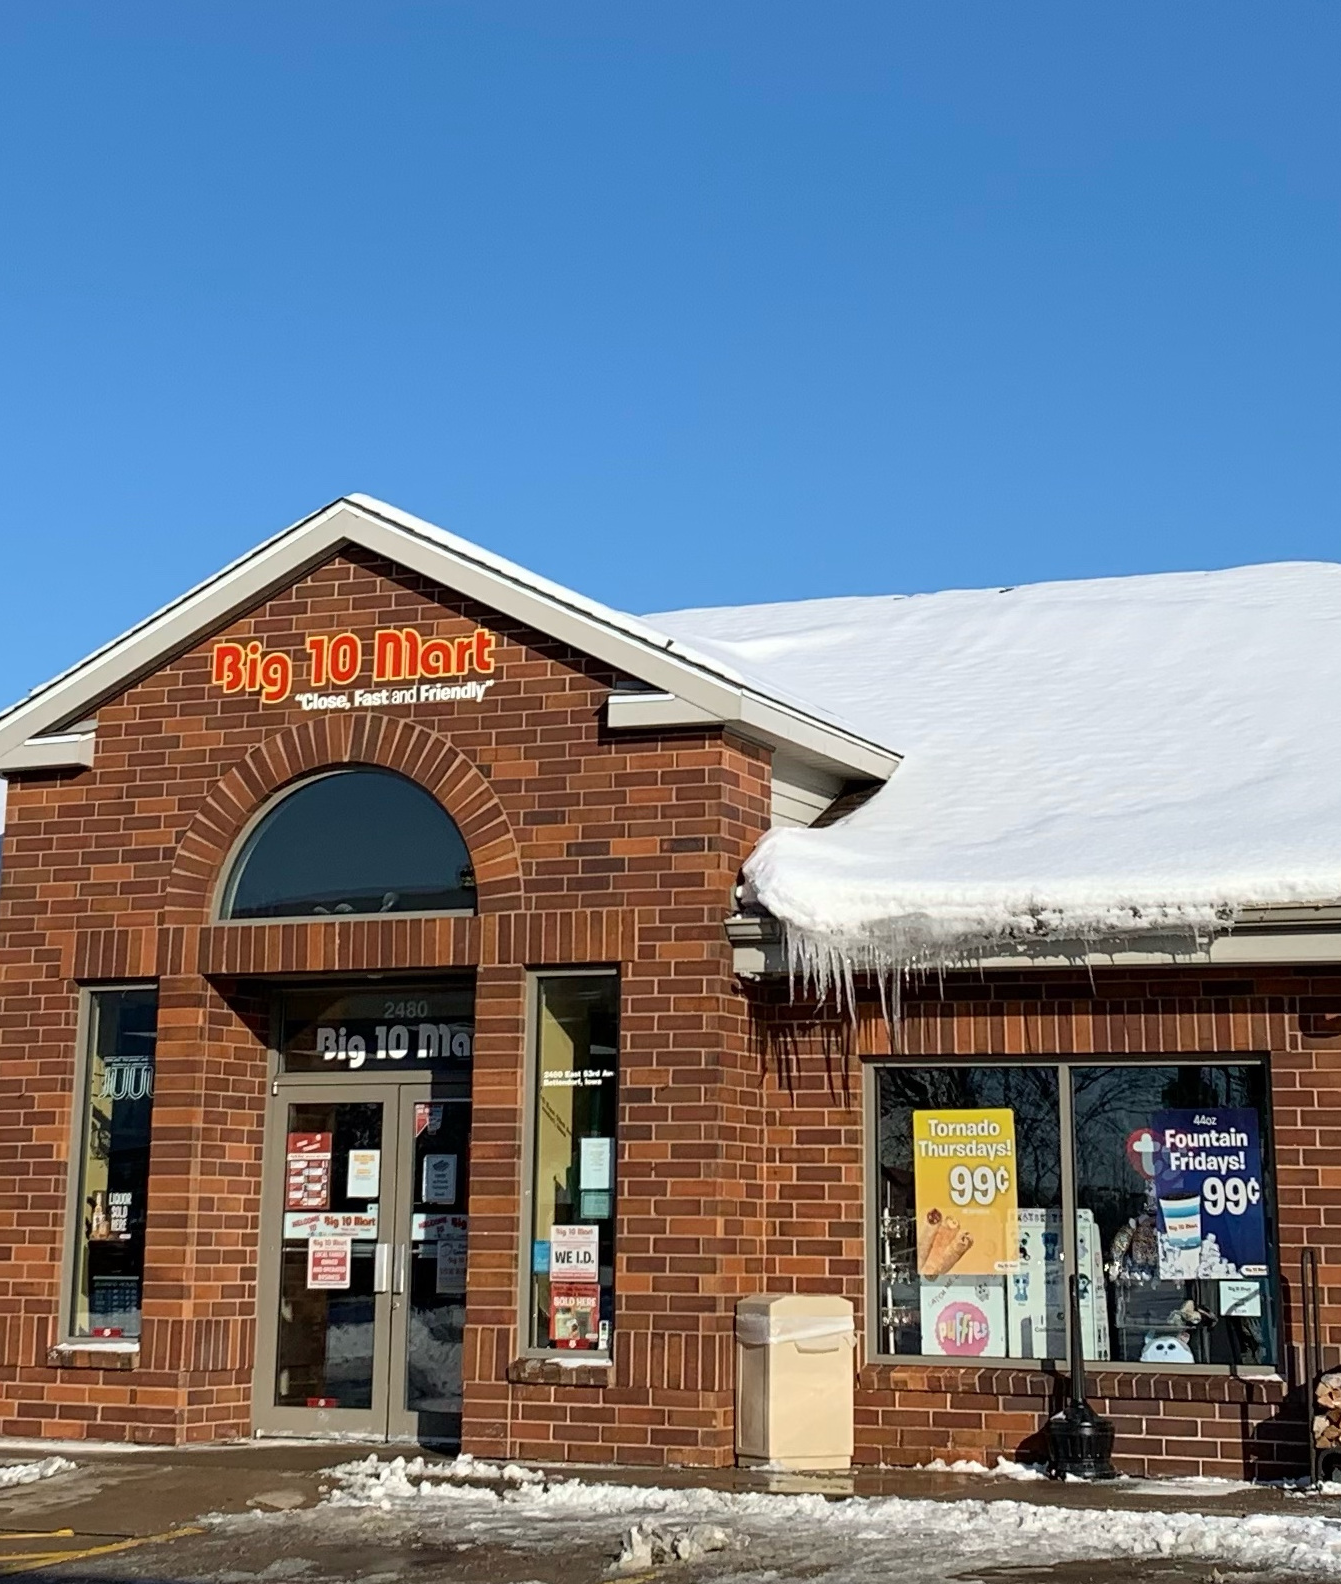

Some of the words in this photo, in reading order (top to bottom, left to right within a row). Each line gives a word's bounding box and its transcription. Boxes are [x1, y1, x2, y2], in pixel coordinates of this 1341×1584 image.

[212, 640, 292, 704] Big
[306, 632, 362, 687] 10
[373, 627, 496, 682] Mart
[354, 690, 389, 707] Fast
[391, 686, 417, 703] and
[384, 1000, 428, 1019] 2480
[317, 1027, 366, 1069] Big
[375, 1025, 409, 1059] 10
[417, 1023, 473, 1059] Ma
[564, 1070, 581, 1078] East
[584, 1078, 602, 1086] Iowa
[928, 1118, 1001, 1137] Tornado
[1193, 1114, 1218, 1125] 44oz
[1164, 1127, 1249, 1148] Fountain
[918, 1139, 1012, 1161] Thursdays!
[1170, 1151, 1246, 1175] Fridays!
[950, 1165, 1009, 1206] 99¢
[109, 1192, 132, 1205] LIQUOR
[1203, 1176, 1260, 1216] 99¢
[111, 1206, 128, 1218] SOLD
[111, 1219, 127, 1231] HERE
[324, 1216, 339, 1228] Big
[342, 1216, 352, 1226] 10
[354, 1216, 376, 1226] Mart
[555, 1250, 573, 1264] WE
[576, 1250, 595, 1264] I.D.
[553, 1296, 575, 1307] SOLD
[576, 1296, 597, 1307] HERE
